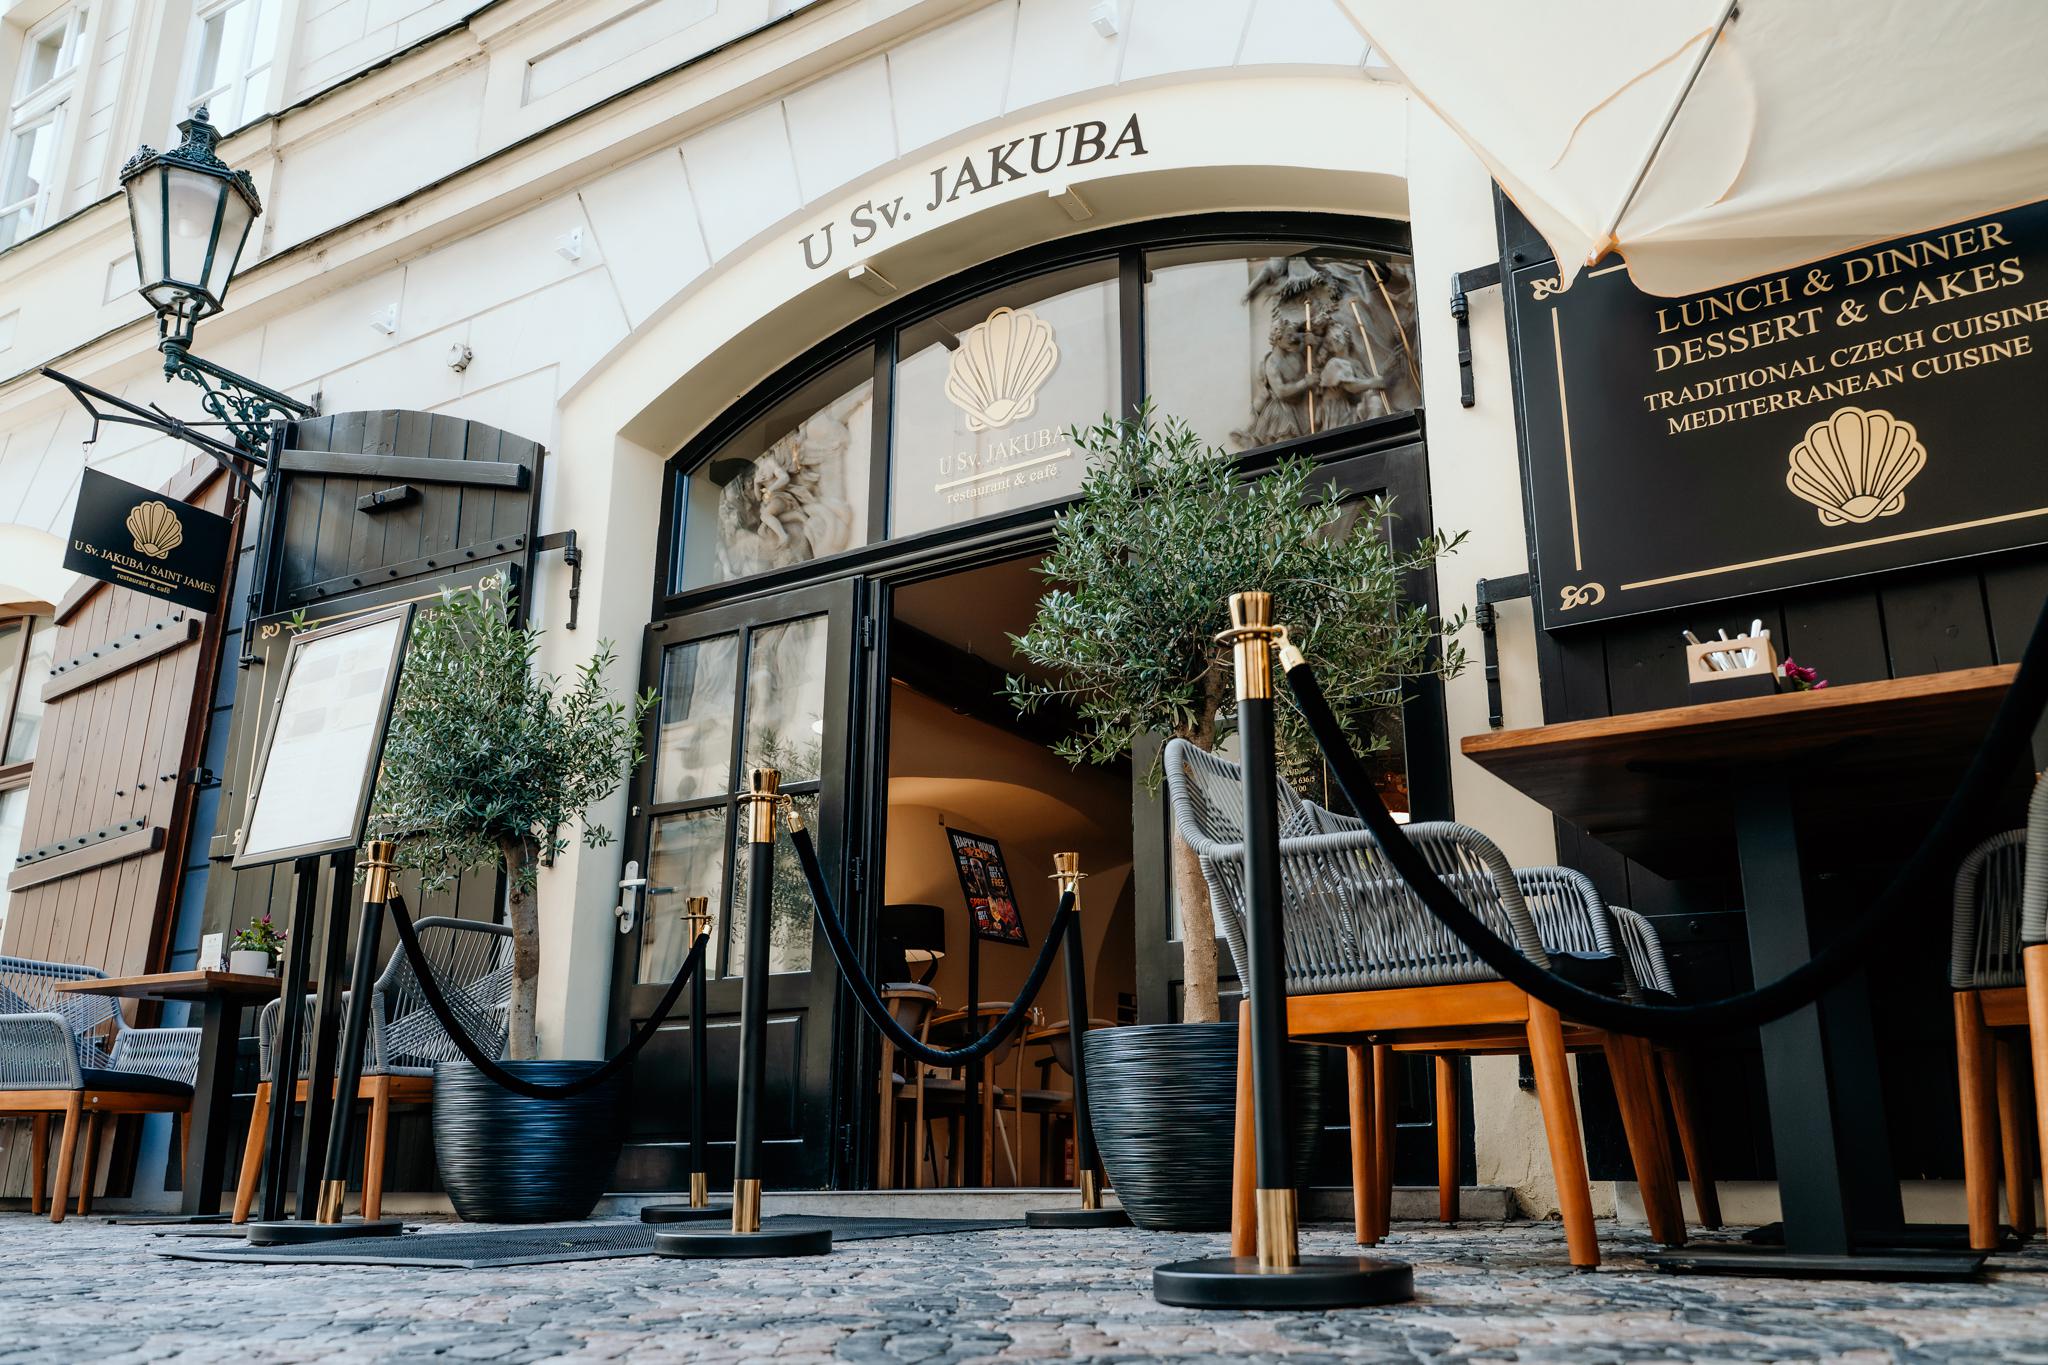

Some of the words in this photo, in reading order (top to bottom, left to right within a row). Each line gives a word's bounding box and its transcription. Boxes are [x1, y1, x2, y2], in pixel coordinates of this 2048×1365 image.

[798, 222, 835, 270] U
[850, 197, 911, 247] Sv.
[926, 112, 1149, 212] JAKUBA
[1654, 306, 1823, 372] DESSERT
[1836, 298, 1868, 327] &
[1878, 256, 2025, 315] CAKES
[1655, 276, 1793, 335] LUNCH
[1803, 269, 1833, 296] &
[1842, 222, 2012, 286] DINNER
[1643, 360, 1825, 412] TRADITIONAL
[1830, 330, 1926, 368] CZECH
[1931, 300, 2048, 343] CUISINE
[1667, 366, 1905, 436] MEDITERRANEAN
[1911, 335, 2033, 379] CUISINE
[939, 455, 952, 475] U
[986, 424, 1066, 463] JAKUBA
[947, 477, 1010, 503] restaurant
[1014, 472, 1026, 486] &
[74, 540, 84, 551] U
[100, 549, 144, 571] JAKUBA
[150, 565, 182, 582] SAINT
[183, 575, 216, 594] JAMES
[116, 573, 149, 588] restaurant
[149, 582, 156, 590] &
